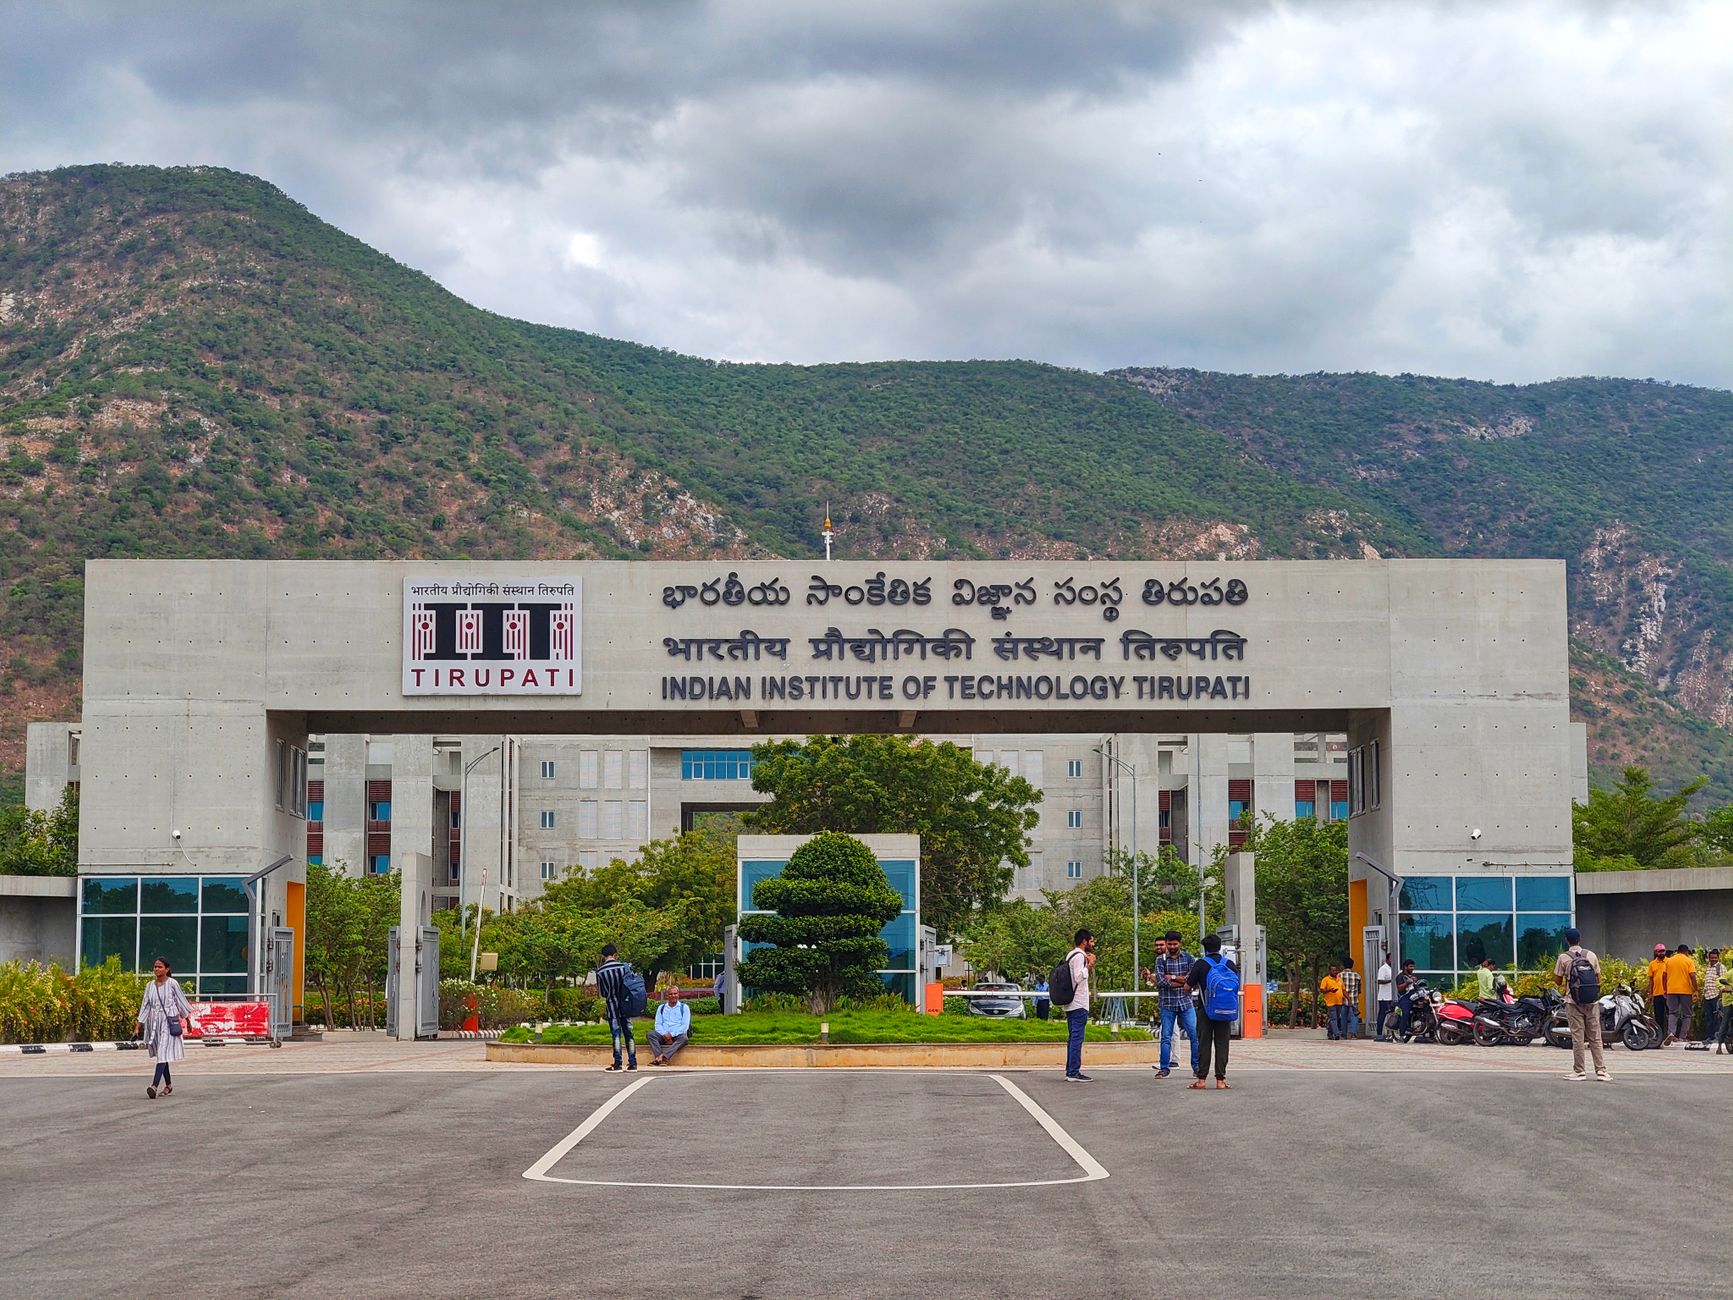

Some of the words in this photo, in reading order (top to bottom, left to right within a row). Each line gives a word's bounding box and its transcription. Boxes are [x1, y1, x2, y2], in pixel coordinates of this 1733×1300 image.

[411, 583, 449, 596] भारतीय
[451, 582, 499, 597] प्रौद्योगिकी
[502, 584, 535, 596] संस्थान
[538, 583, 575, 596] तिरुपति
[662, 572, 791, 609] భారతీయ
[806, 572, 932, 606] సాంకేతిక
[952, 577, 1037, 621] విజ్ఞాన
[1054, 577, 1123, 622] సంస్థ
[1142, 577, 1249, 606] తిరుపతి
[423, 603, 562, 660] IIT
[662, 629, 791, 661] भारतीय
[808, 626, 976, 663] प्रौद्योगिकी
[991, 630, 1105, 661] संस्थान
[1119, 629, 1249, 661] तिरुपति
[411, 668, 574, 687] TIRUPATI
[662, 676, 751, 700] INDIAN
[761, 675, 894, 701] INSTITUTE
[902, 675, 938, 700] OF
[944, 675, 1126, 701] TECHNOLOGY
[1133, 675, 1250, 701] TIRUPATI
